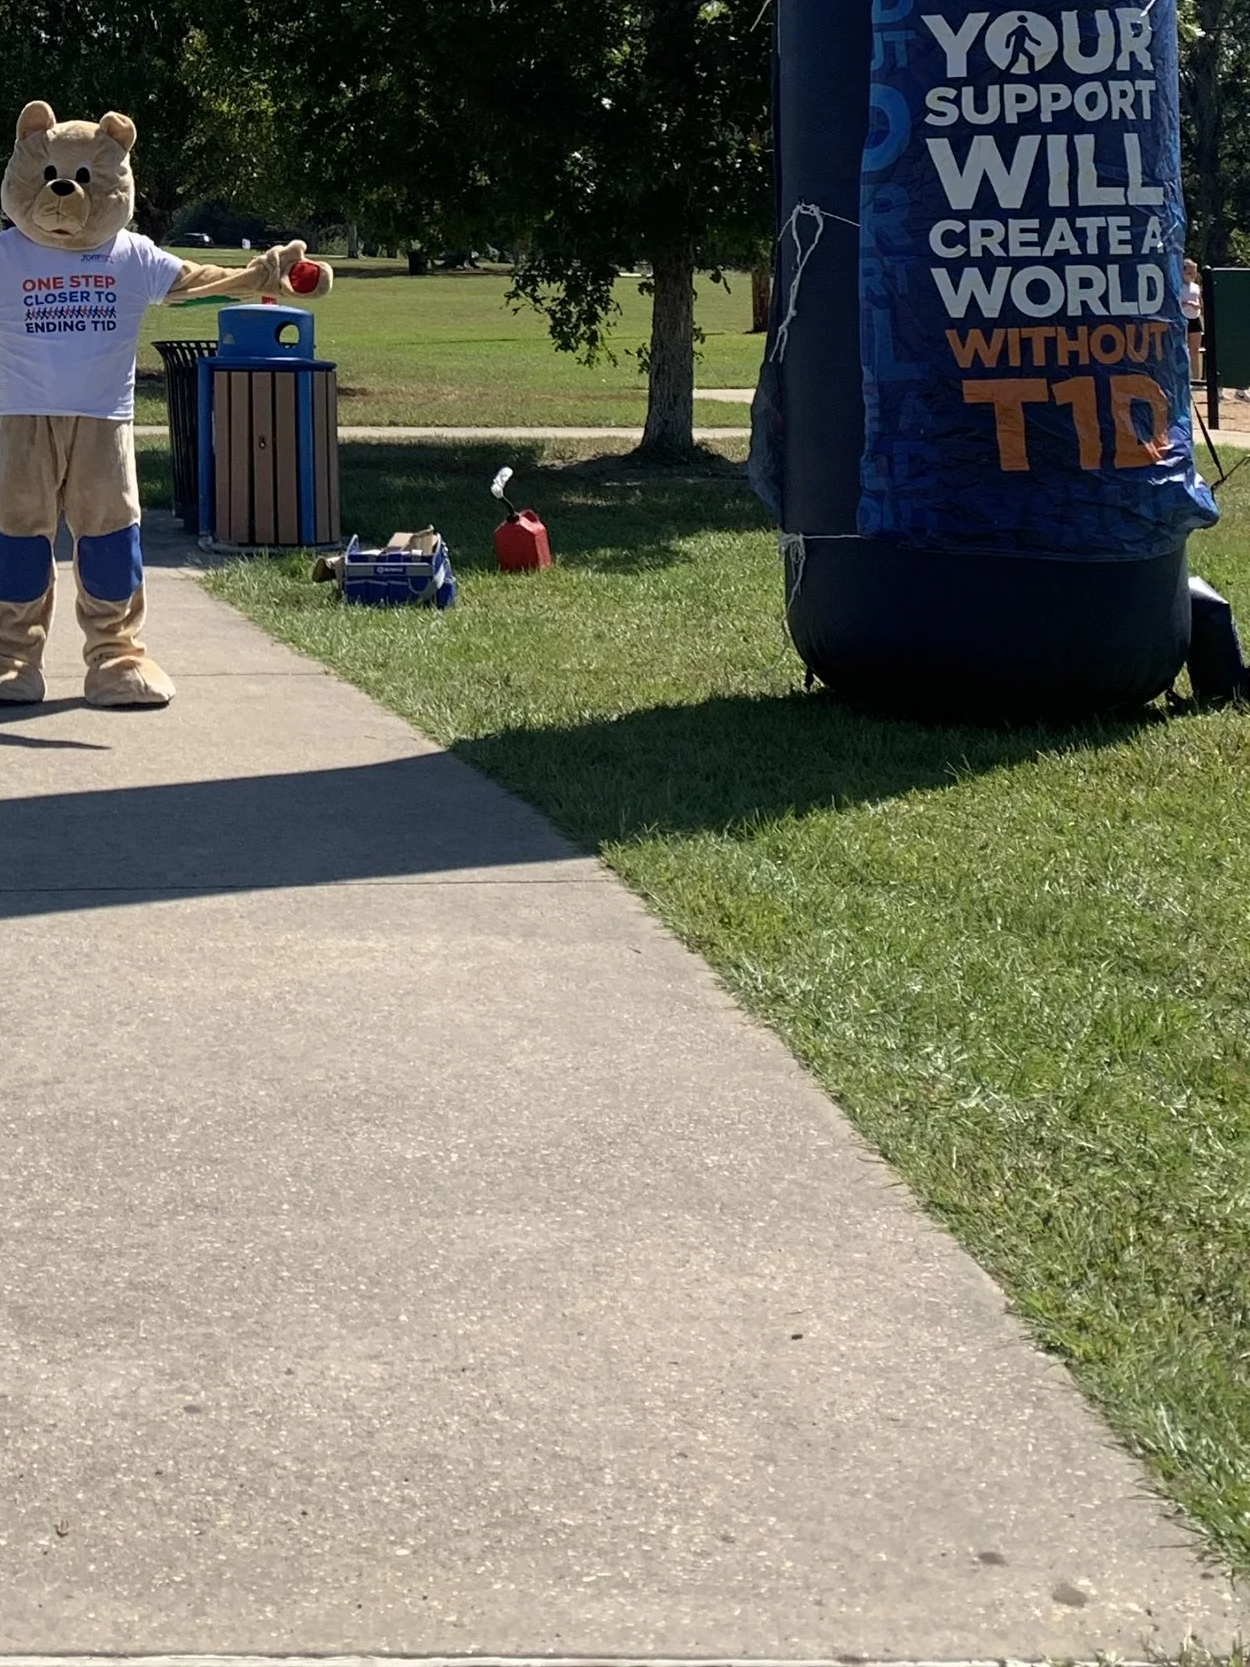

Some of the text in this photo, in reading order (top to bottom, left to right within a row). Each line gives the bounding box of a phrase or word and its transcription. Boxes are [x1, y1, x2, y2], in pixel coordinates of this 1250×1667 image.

[921, 7, 1154, 79] YOUR
[924, 79, 1157, 127] SUPPORT
[926, 134, 1165, 210] WILL
[929, 215, 1165, 258] CREATE A
[22, 275, 116, 292] ONE STEP
[23, 291, 117, 307] CLOSER TO
[930, 264, 1165, 319] WORLD
[25, 320, 117, 334] ENDING T1D
[946, 322, 1167, 369] WITHOUT
[962, 374, 1169, 472] T1D
